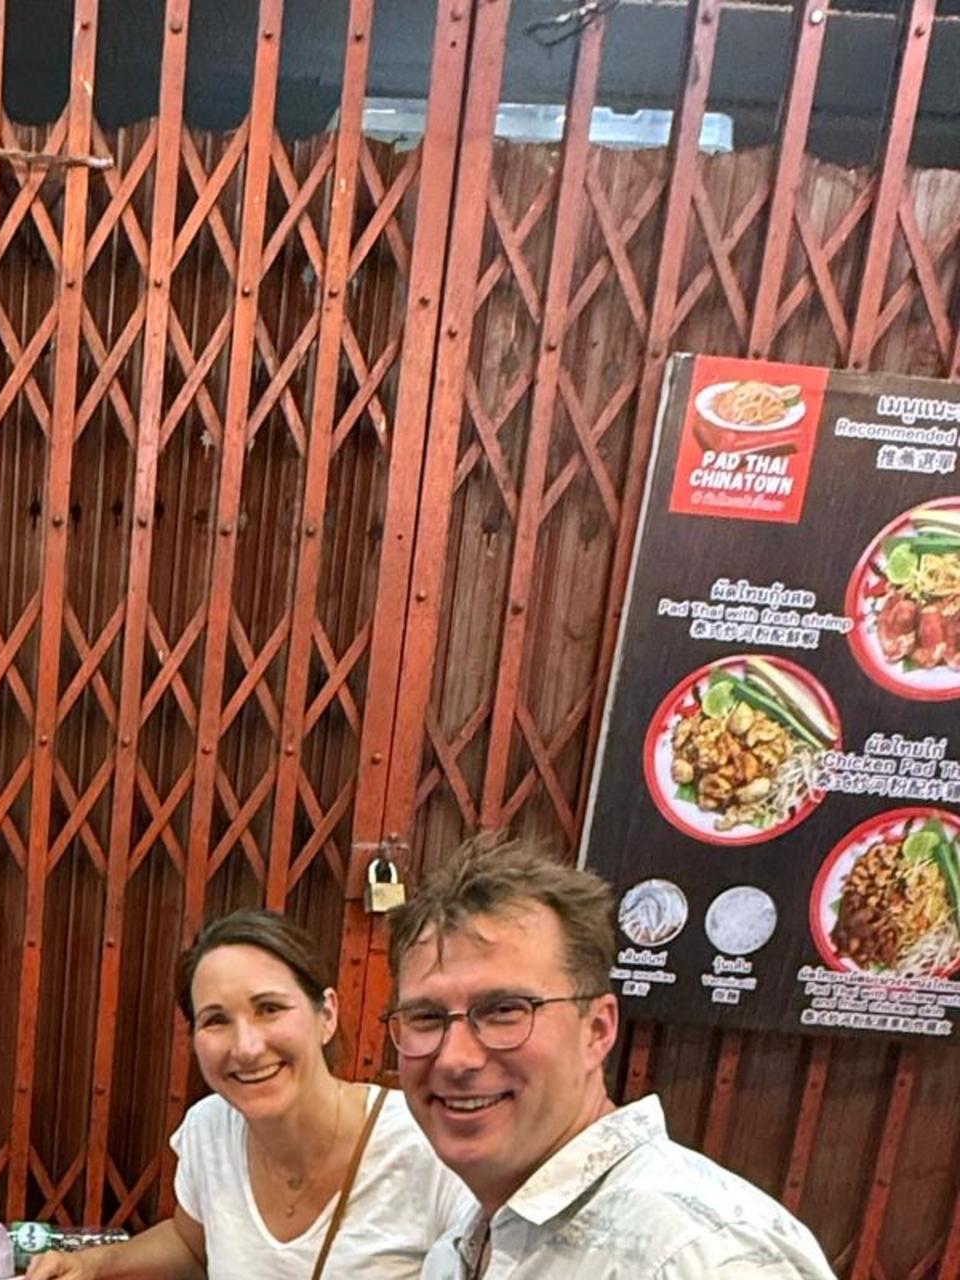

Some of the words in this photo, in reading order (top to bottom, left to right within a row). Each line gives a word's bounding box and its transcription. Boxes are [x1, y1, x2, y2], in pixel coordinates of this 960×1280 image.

[878, 395, 960, 424] เมนูแนะ
[835, 417, 957, 446] Recommended
[702, 450, 741, 471] PAD
[745, 454, 790, 475] THAI
[689, 469, 794, 496] CHINATOWN
[658, 599, 689, 617] Pad
[690, 602, 724, 620] Thai
[725, 606, 759, 623] with
[760, 609, 800, 627] fresh
[801, 613, 854, 633] shrimp
[822, 751, 897, 774] Chicken
[898, 757, 937, 778] Pad
[939, 759, 960, 780] Th
